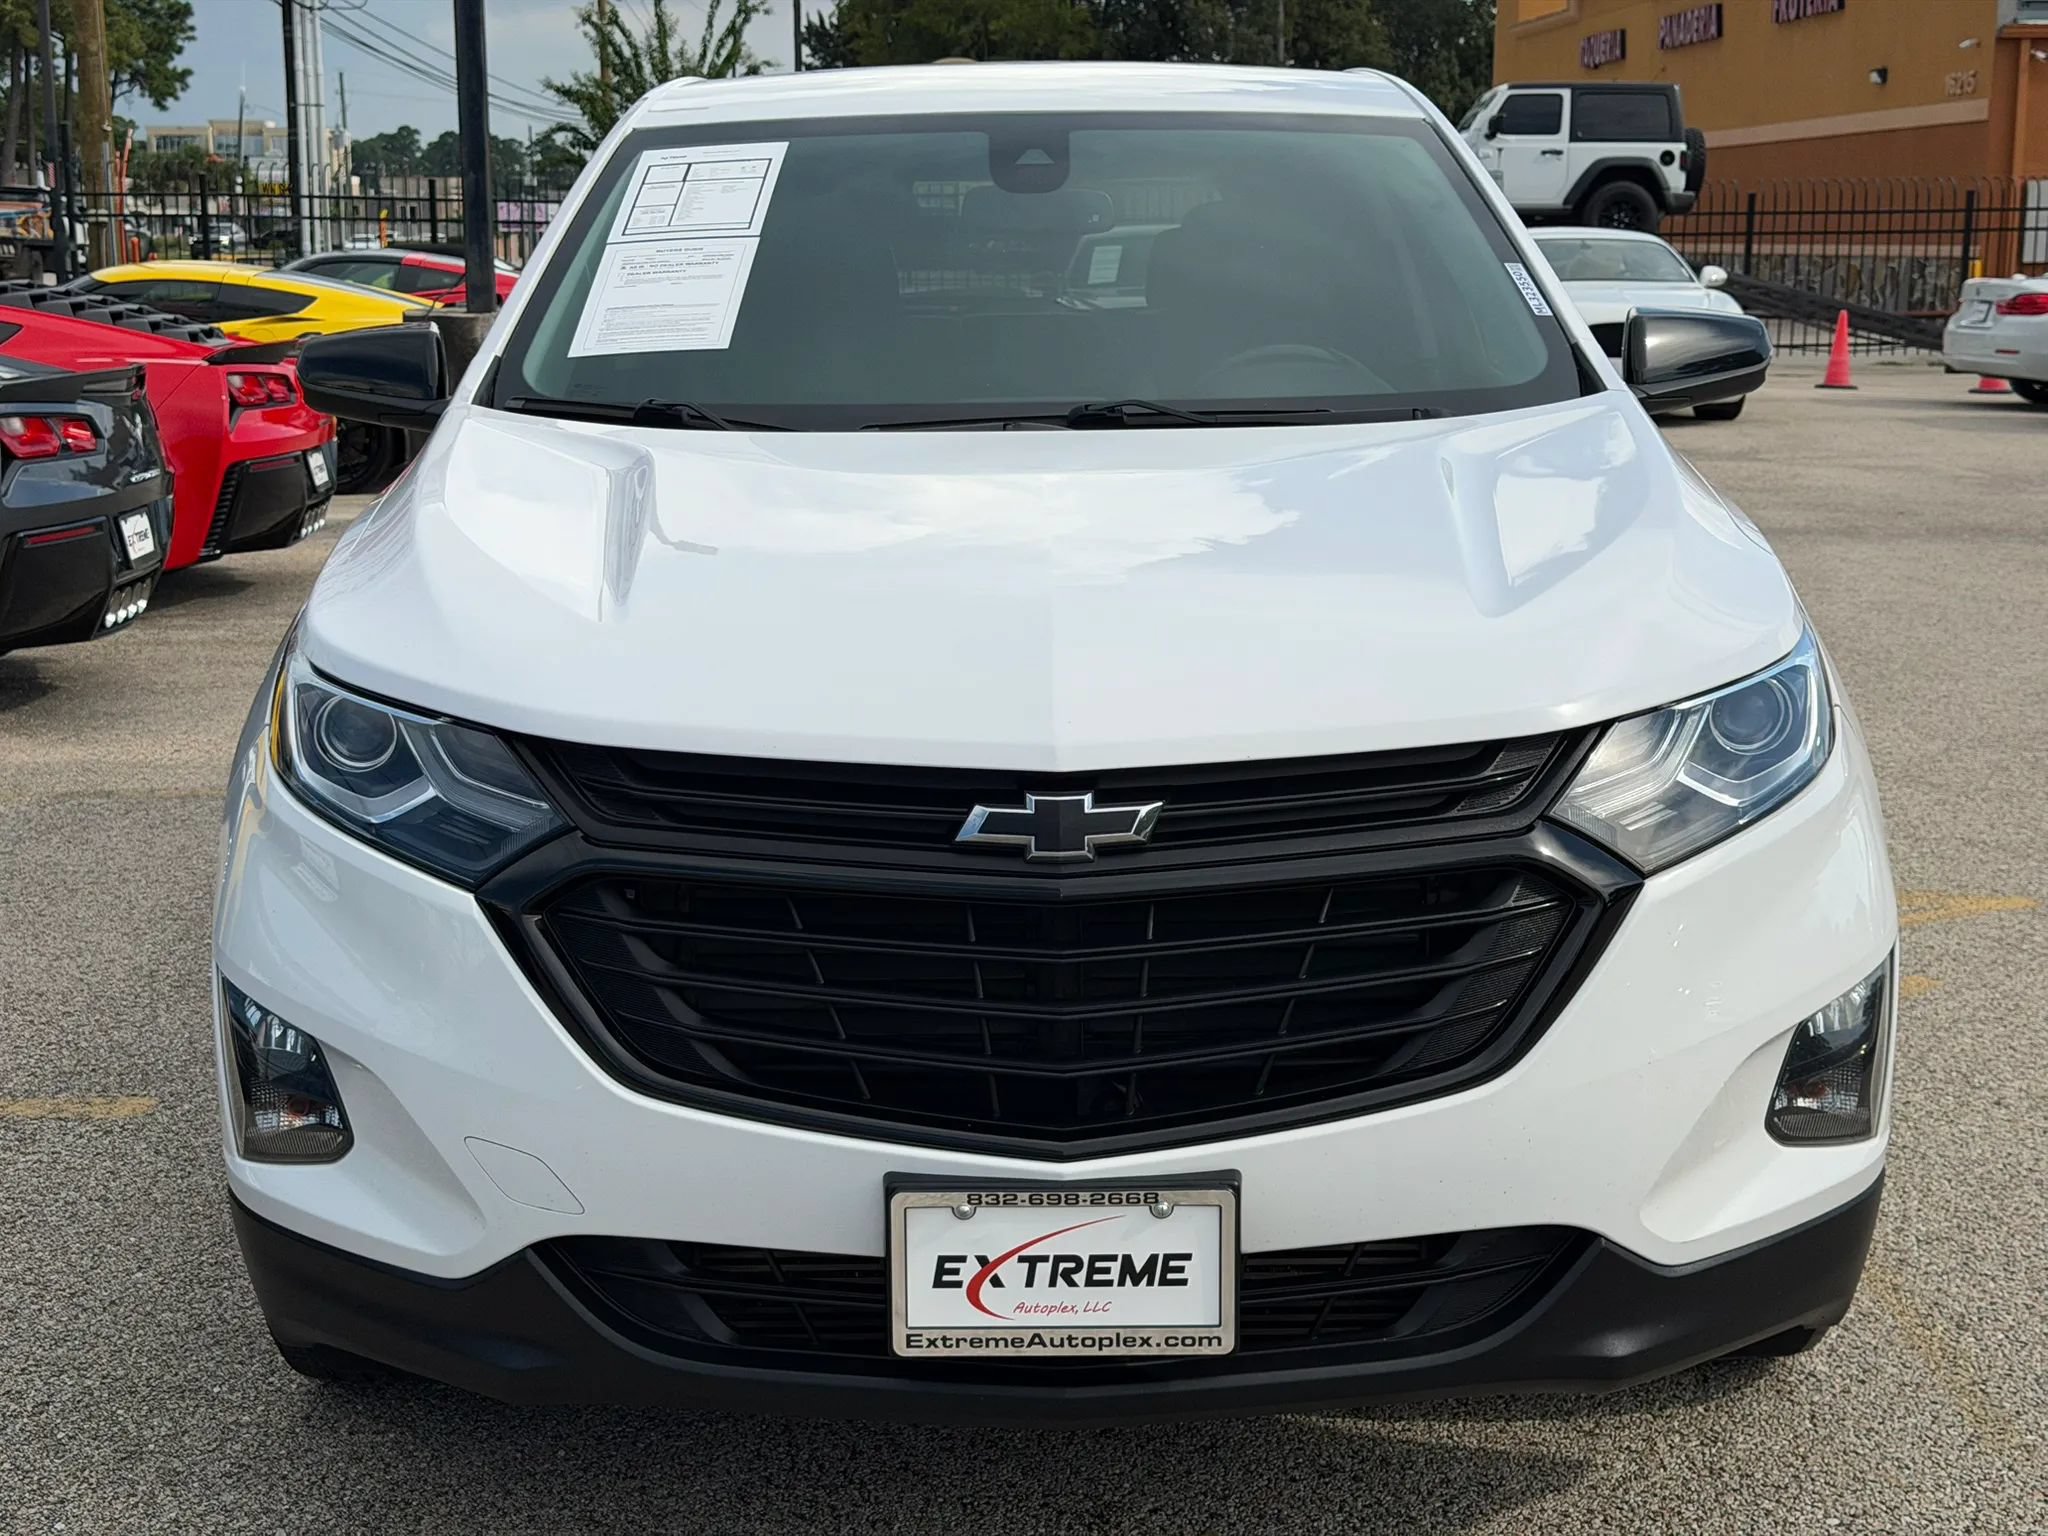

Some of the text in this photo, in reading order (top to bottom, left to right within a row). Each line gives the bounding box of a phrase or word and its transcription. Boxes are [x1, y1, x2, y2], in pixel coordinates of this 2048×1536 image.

[1658, 5, 1718, 50] PANADERIA
[966, 1192, 1160, 1207] 832-698-2668
[931, 1252, 1193, 1289] EXTREME
[1013, 1301, 1113, 1317] Autoplex, LLC
[905, 1332, 1223, 1351] ExtremeAutoplex.com
